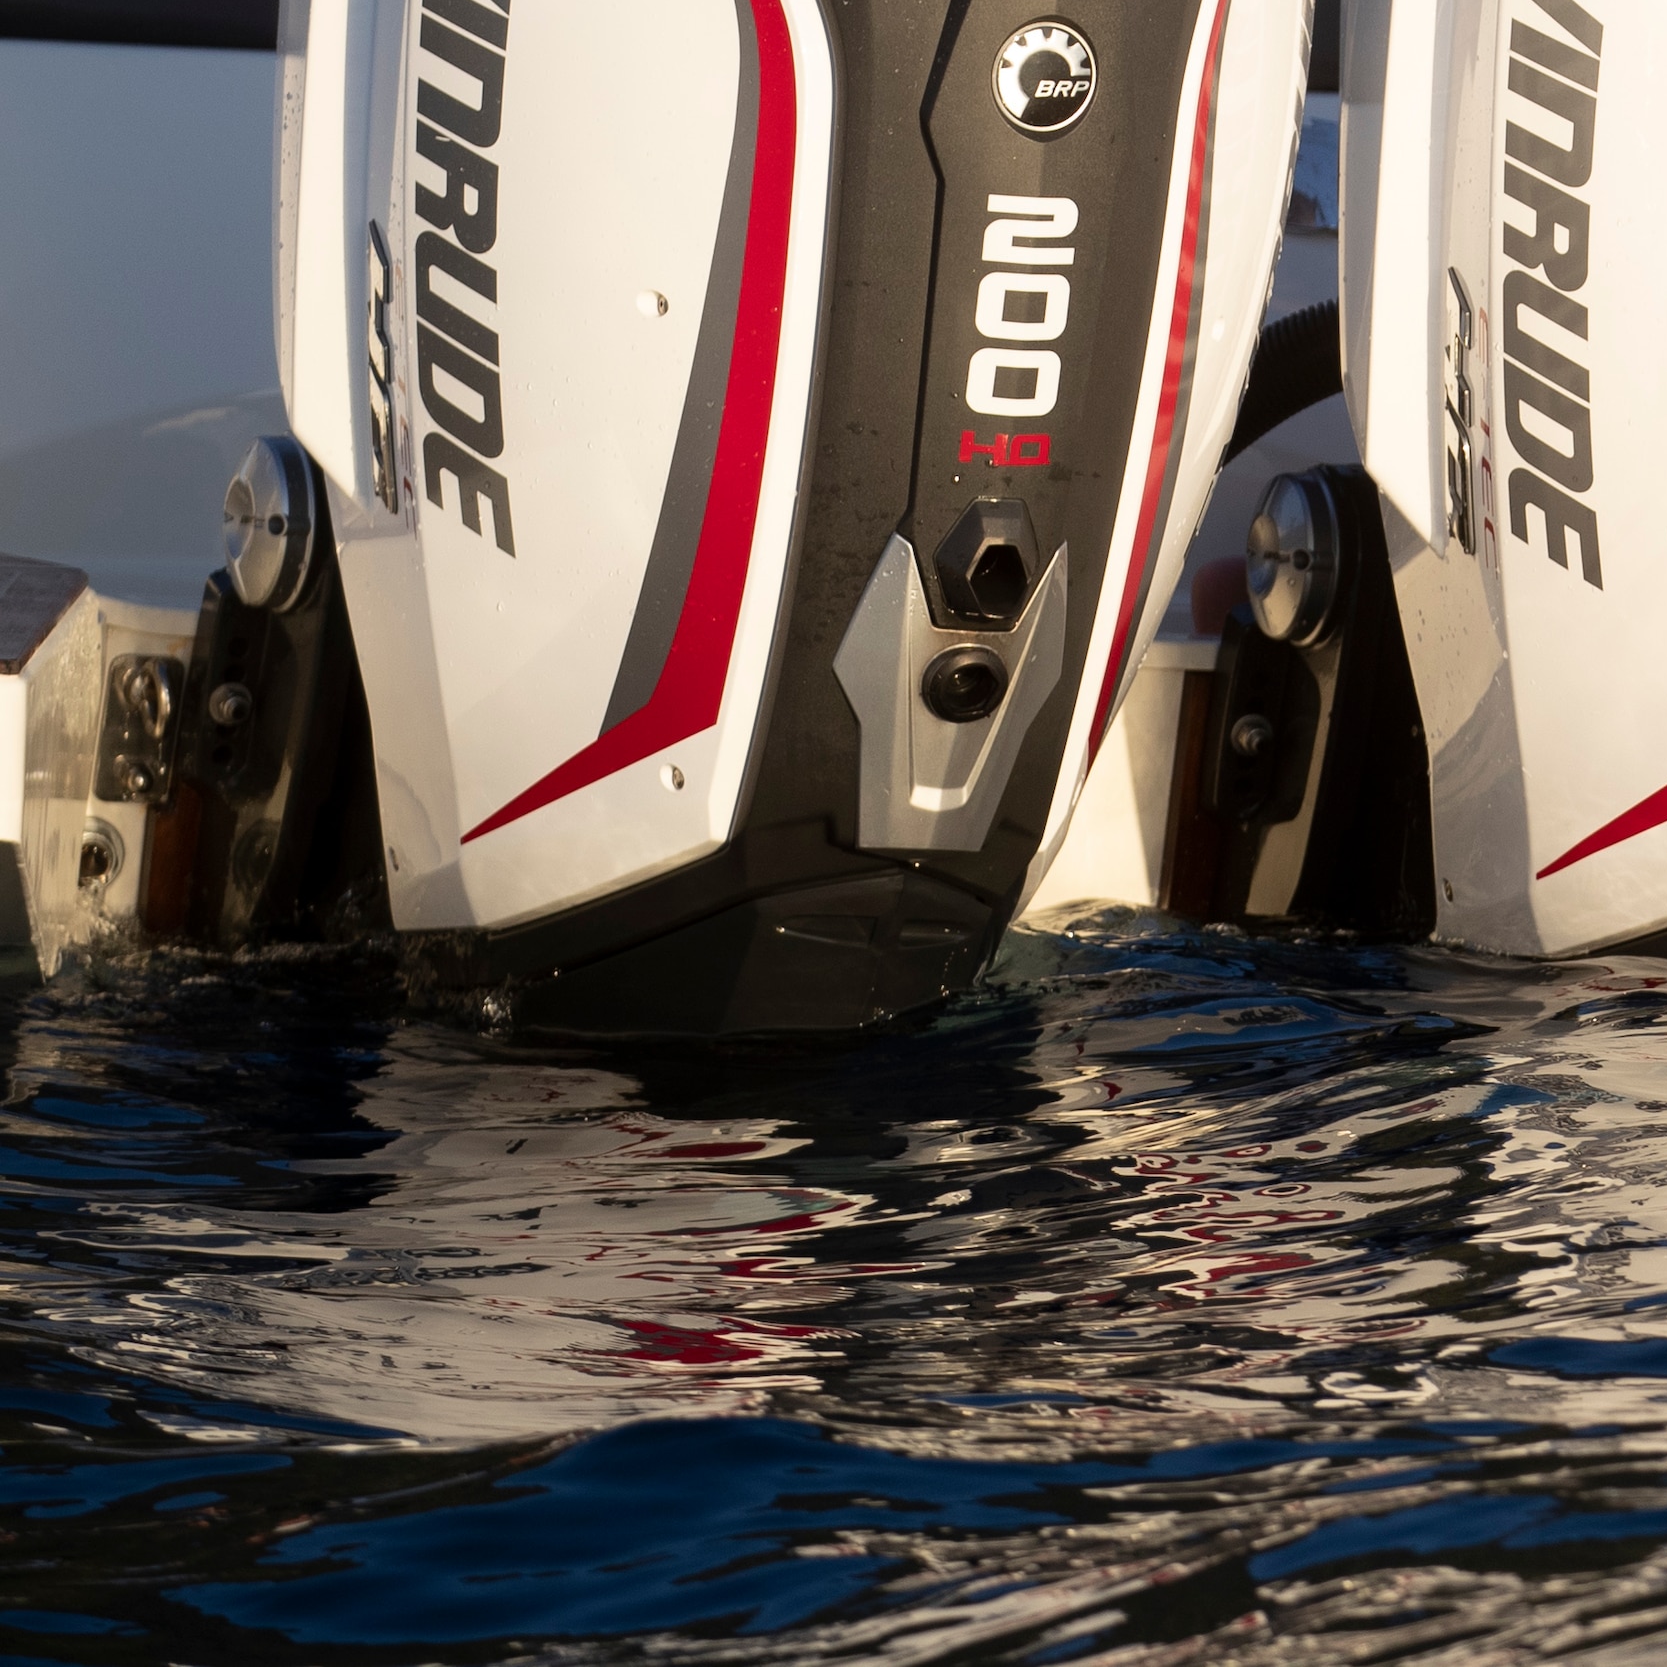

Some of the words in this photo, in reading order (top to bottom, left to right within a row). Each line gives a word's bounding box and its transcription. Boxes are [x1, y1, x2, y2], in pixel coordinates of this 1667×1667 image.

[1034, 79, 1090, 99] BRP
[965, 193, 1079, 417] 200
[958, 429, 1051, 467] HO
